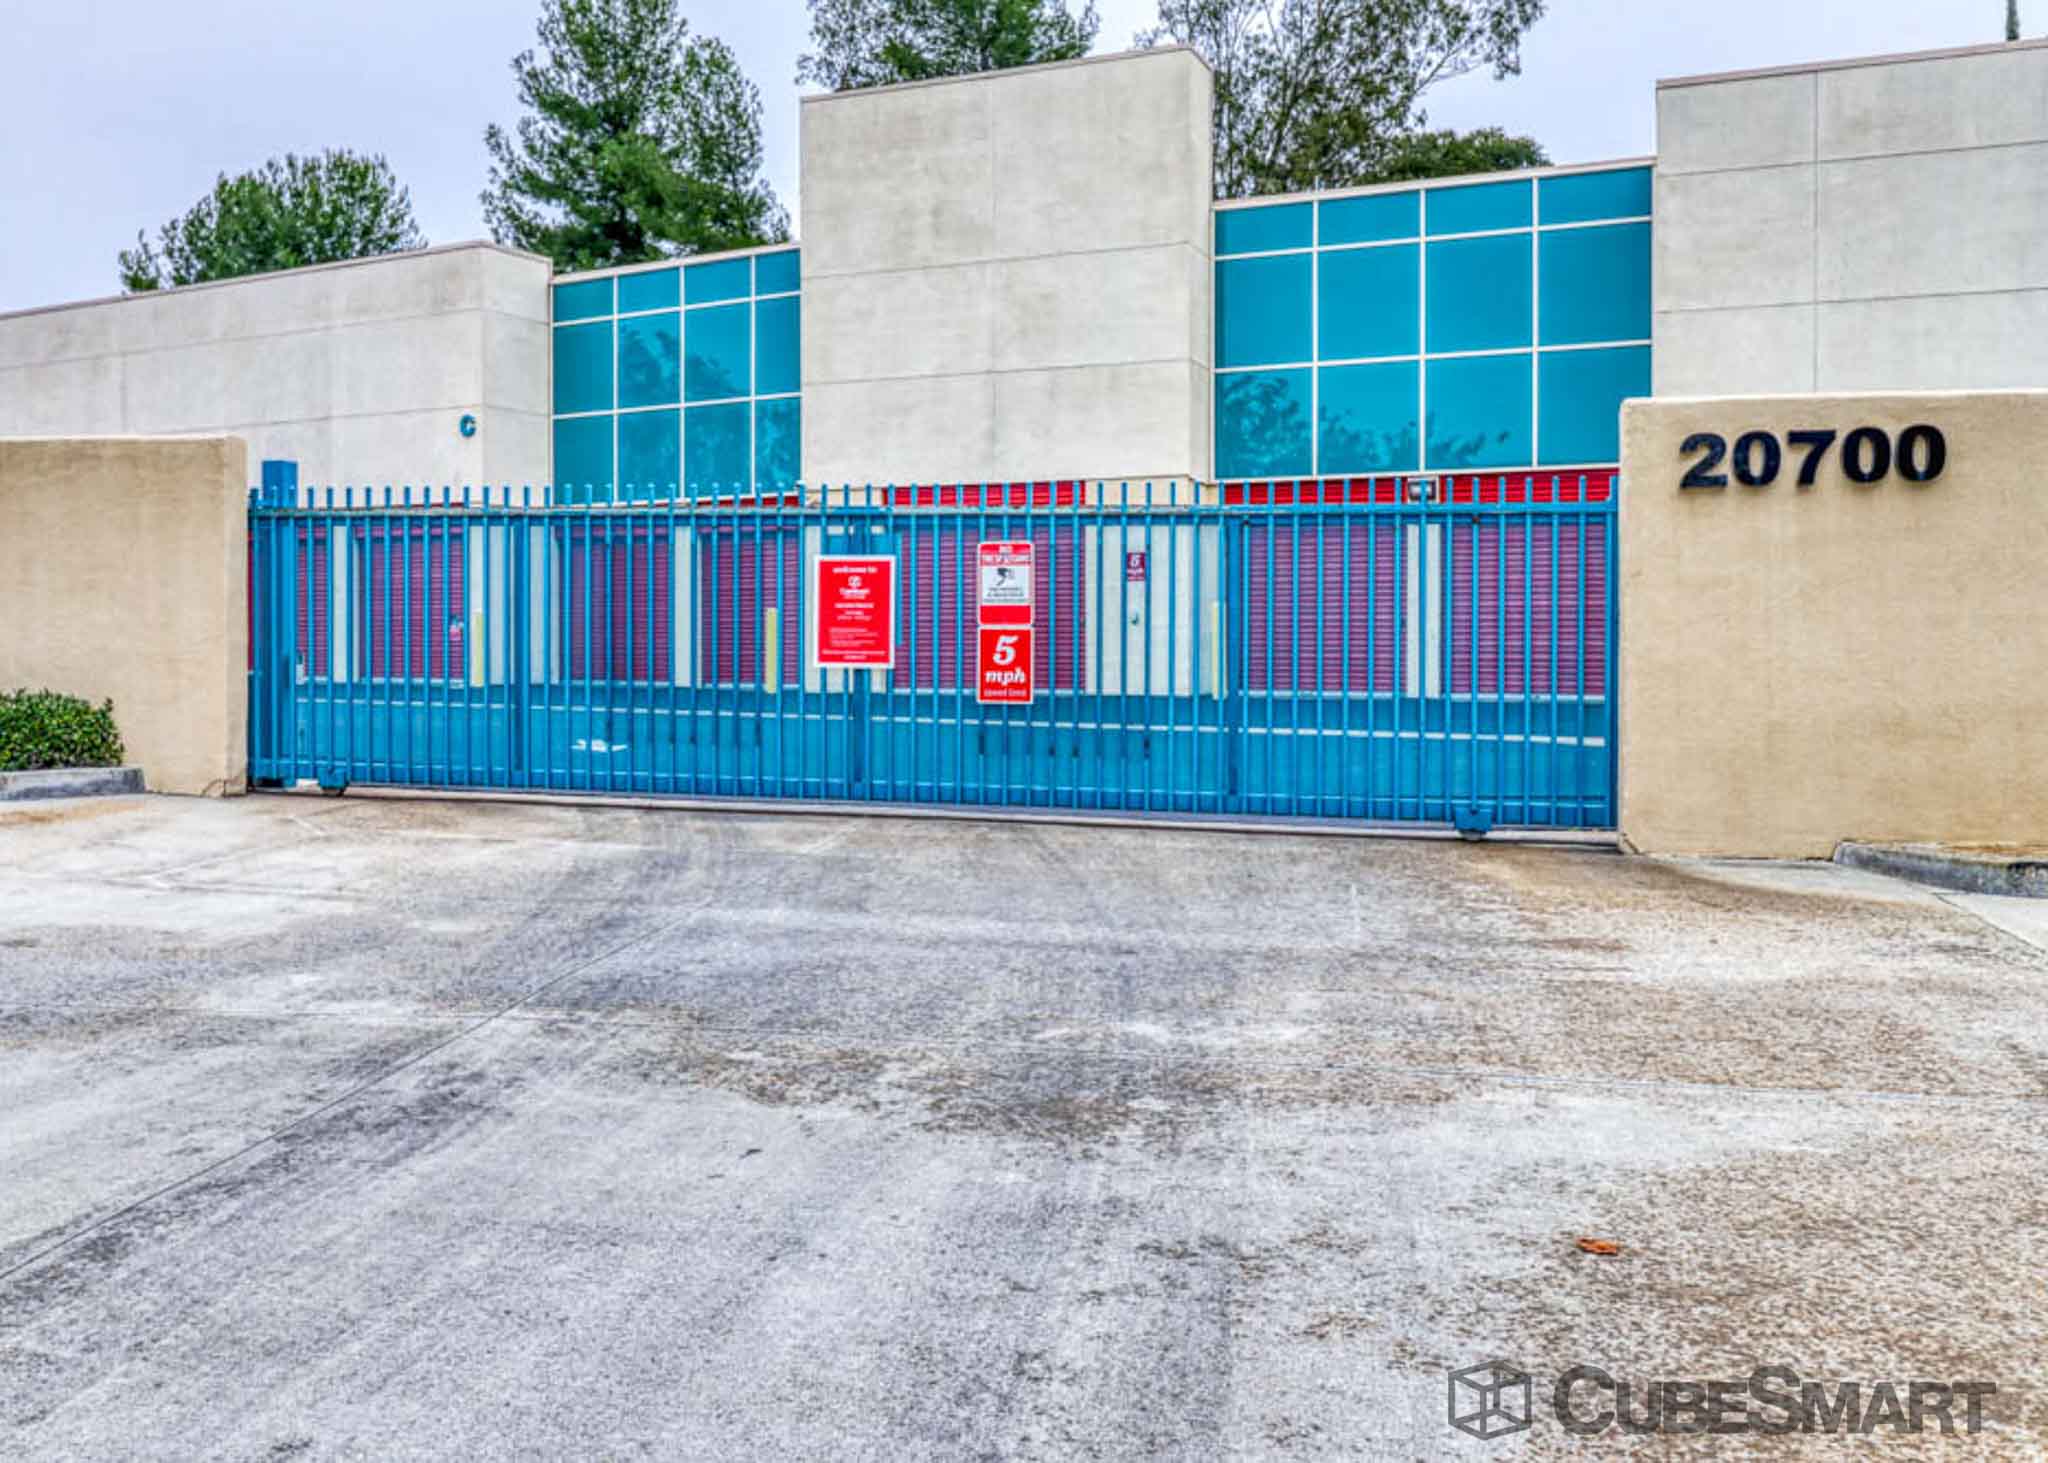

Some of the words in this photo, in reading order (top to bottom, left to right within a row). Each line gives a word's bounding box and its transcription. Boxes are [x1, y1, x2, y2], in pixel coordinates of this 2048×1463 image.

[1679, 424, 1947, 490] 20700
[993, 635, 1019, 666] 5
[985, 667, 1026, 686] mph
